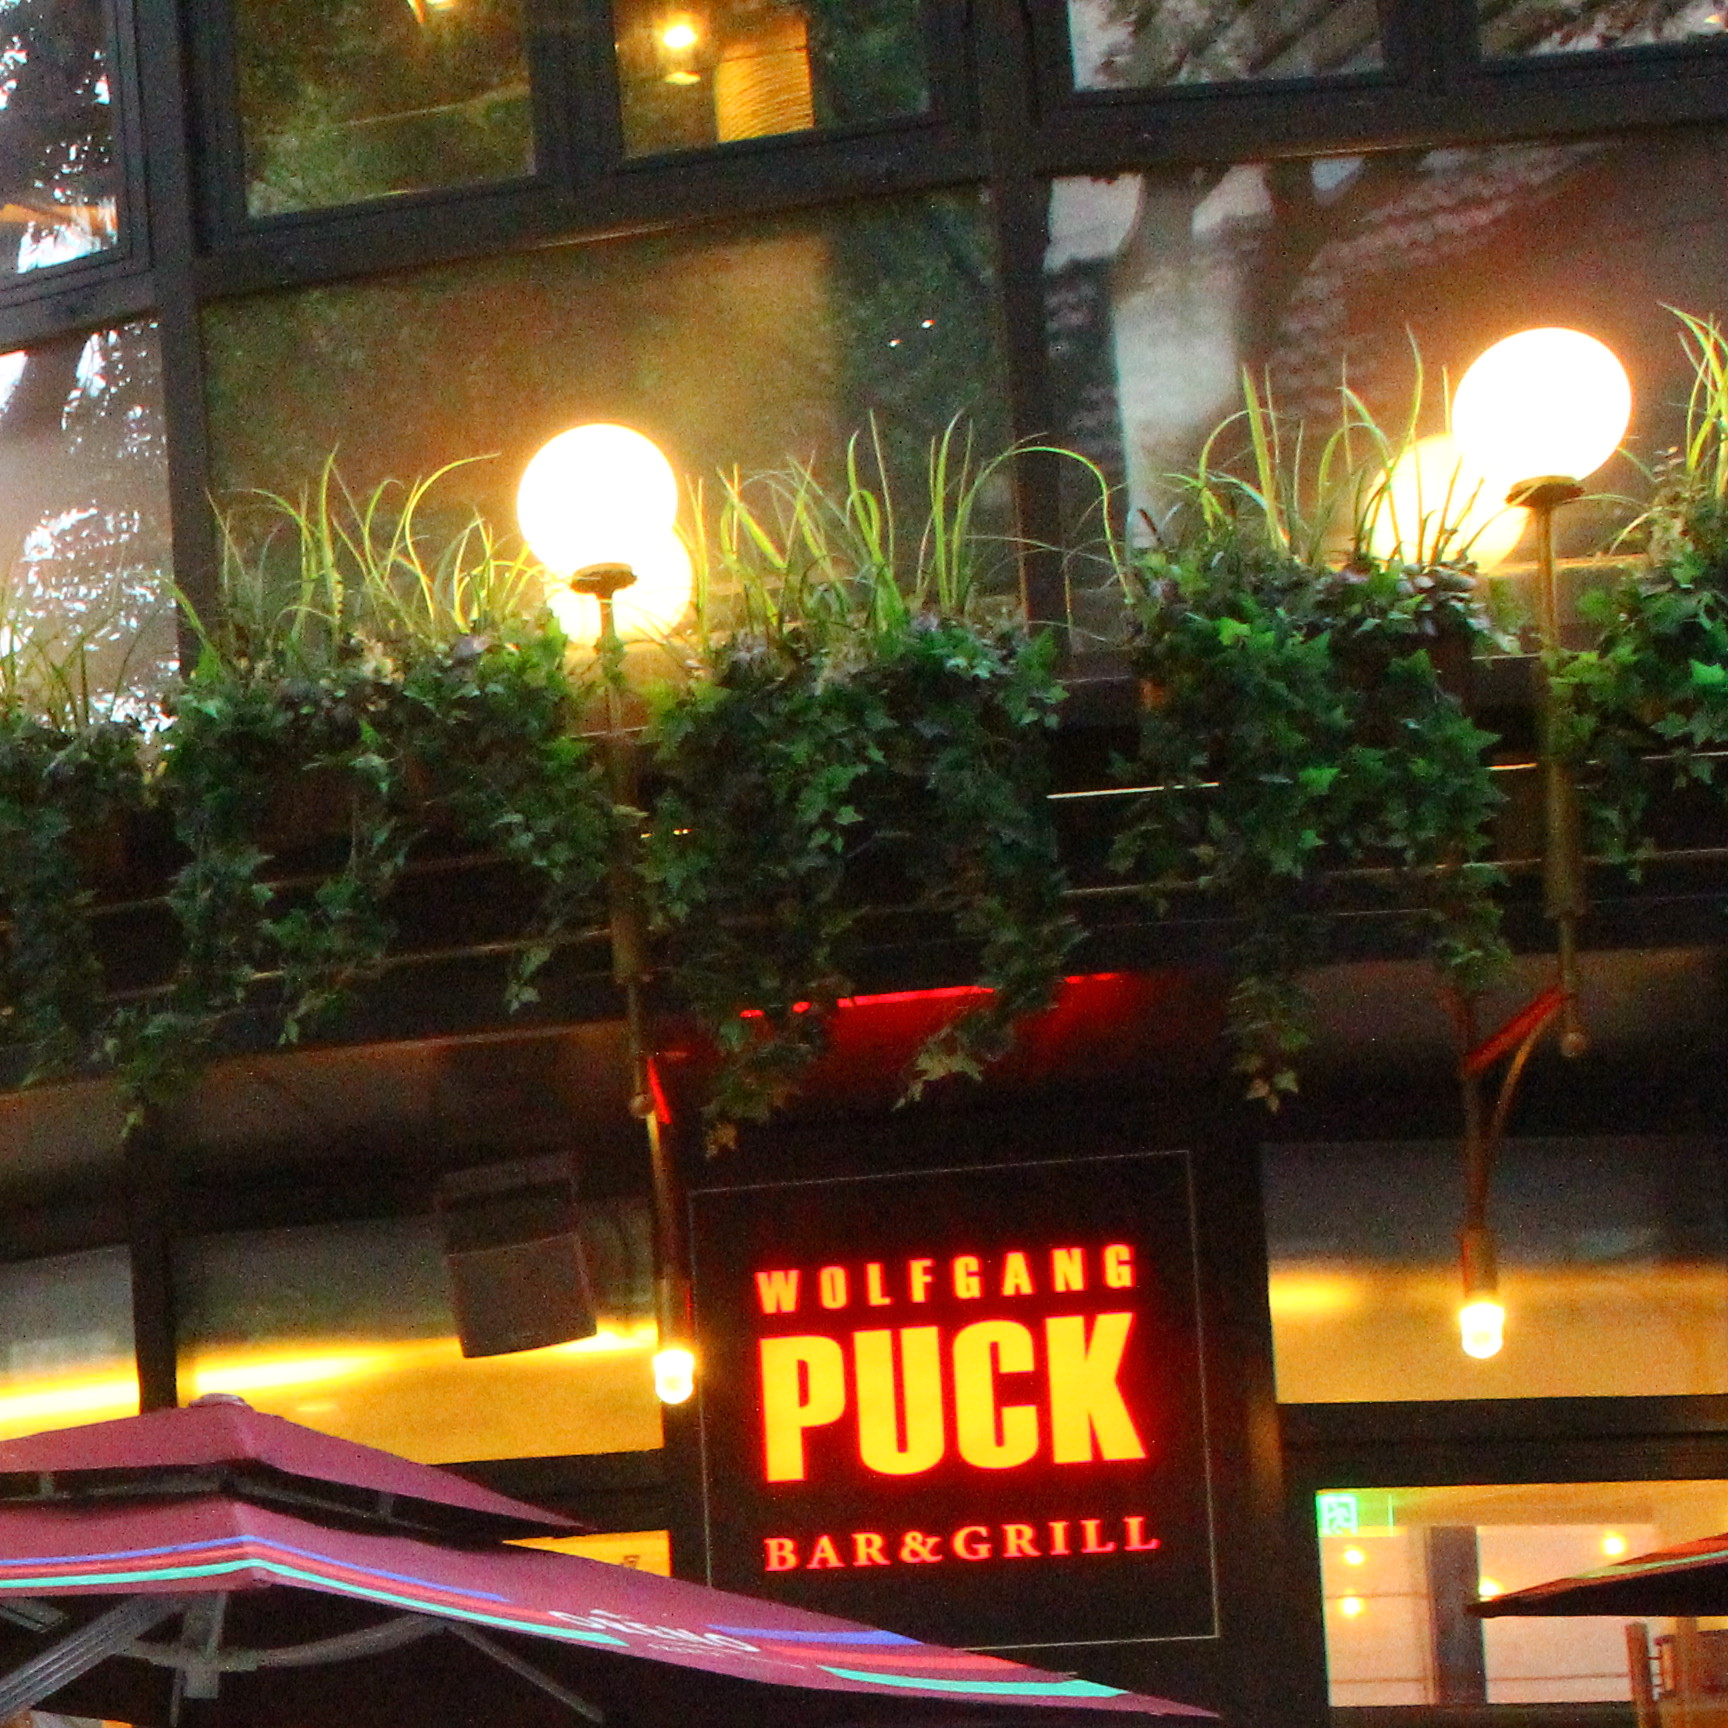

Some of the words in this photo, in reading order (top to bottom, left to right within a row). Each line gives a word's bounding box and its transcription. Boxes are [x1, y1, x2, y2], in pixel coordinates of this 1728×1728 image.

[754, 1243, 1138, 1315] WOLFGANG
[758, 1311, 1147, 1484] PUCK
[763, 1515, 1161, 1572] BAR&GRILL
